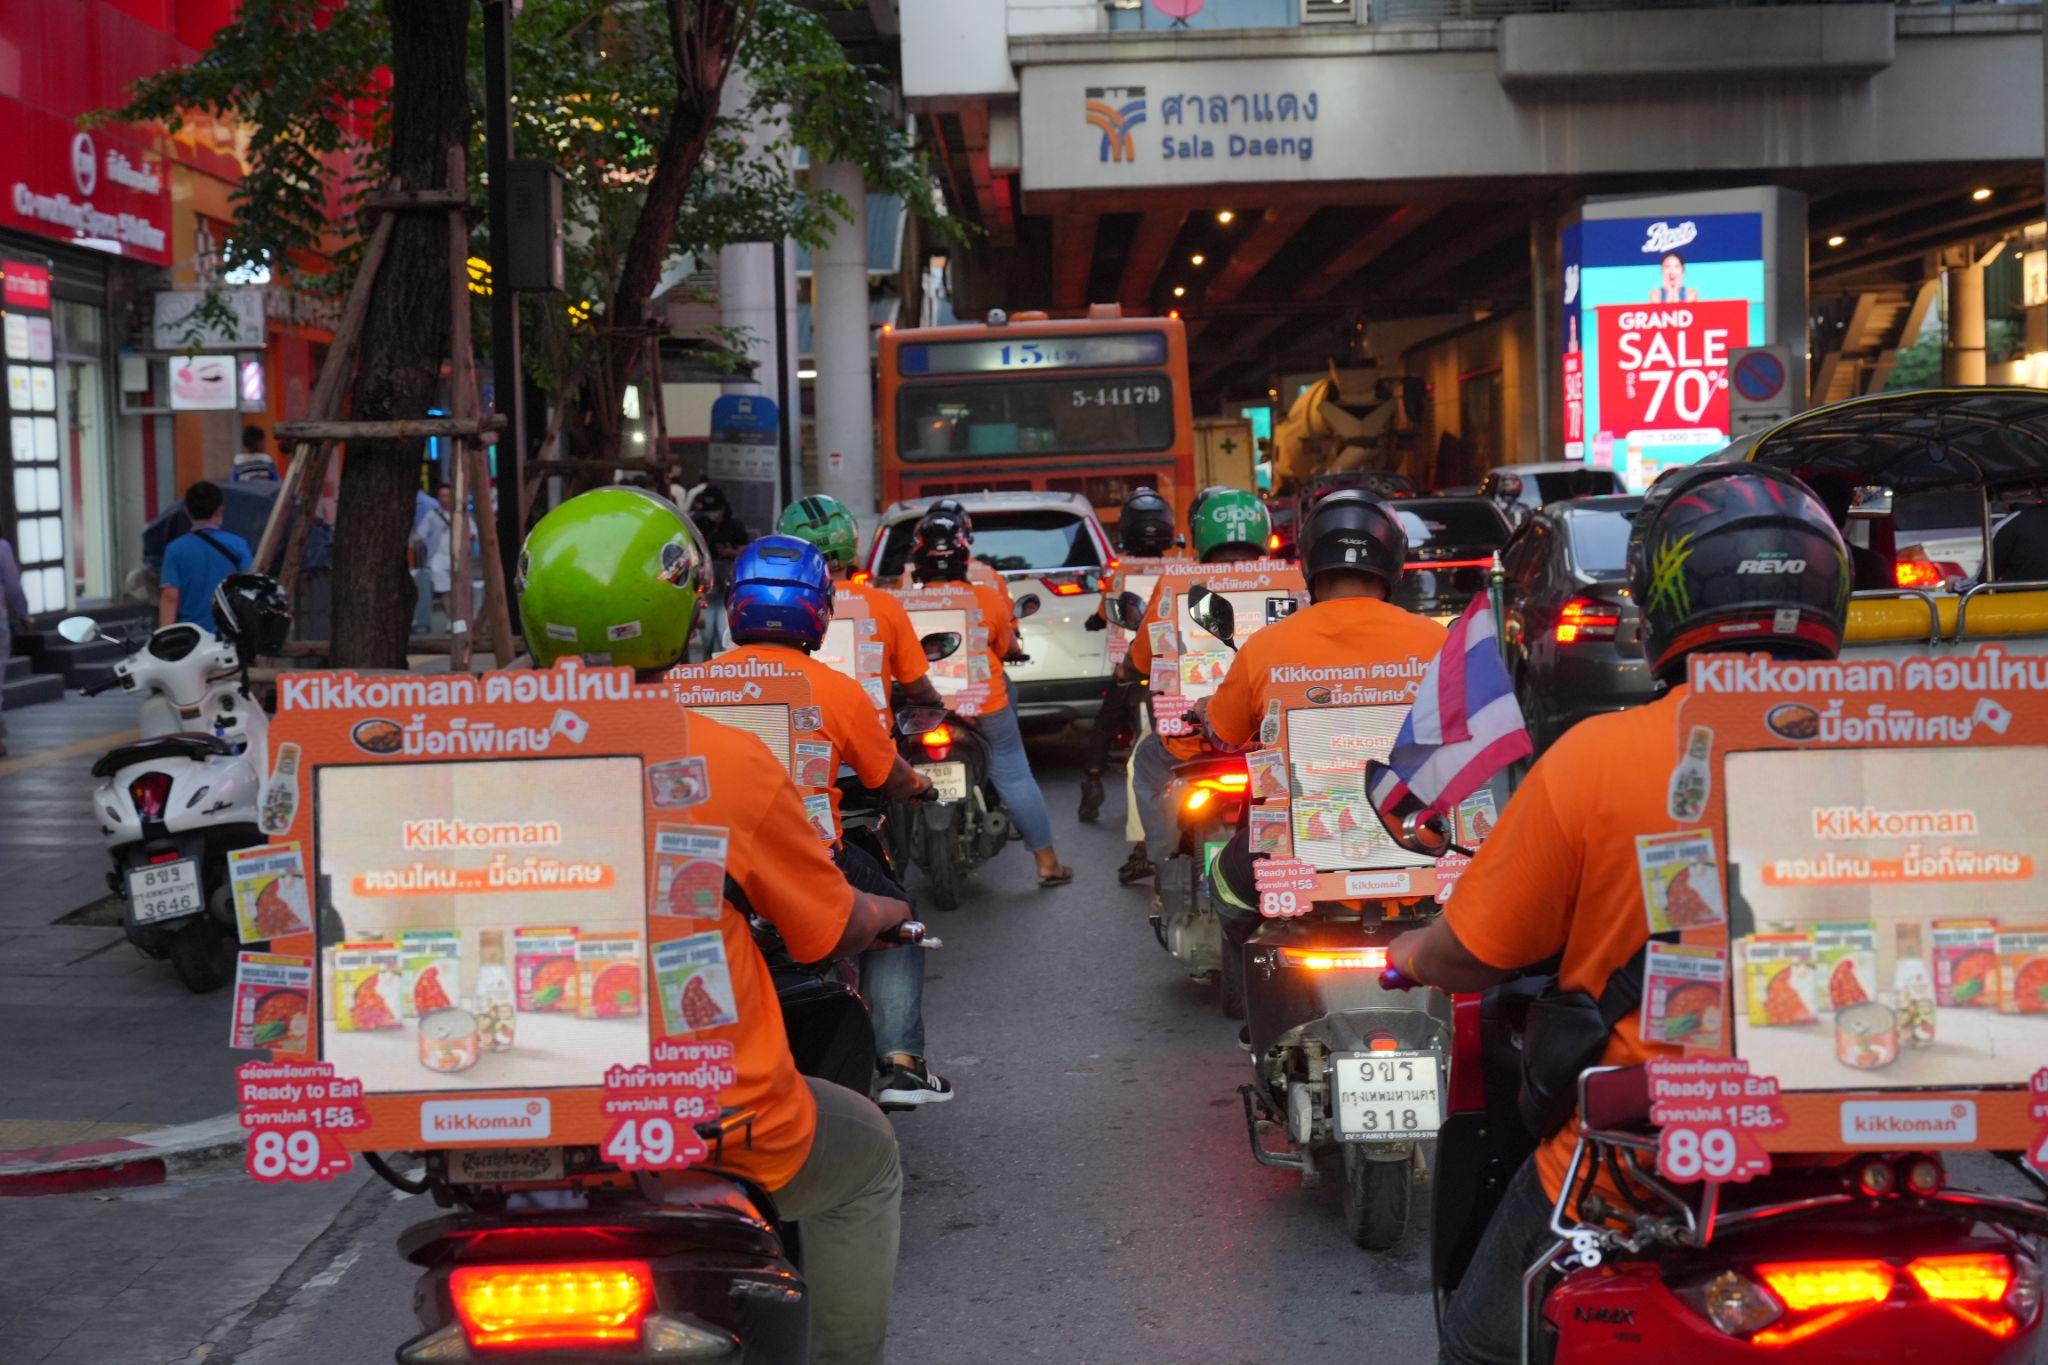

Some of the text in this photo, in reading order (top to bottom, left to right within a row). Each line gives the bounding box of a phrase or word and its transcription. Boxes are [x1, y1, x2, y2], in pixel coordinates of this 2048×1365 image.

[1161, 92, 1318, 125] ศาลาแดง
[1162, 134, 1313, 160] Sala Daeng
[1641, 220, 1698, 252] Boots
[1617, 309, 1693, 330] GRAND
[1001, 344, 1044, 366] 15
[1617, 328, 1729, 371] SALE
[1072, 386, 1161, 408] 5-44179
[1639, 366, 1729, 423] 70%
[1165, 562, 1232, 576] Kikkoman
[1736, 559, 1807, 575] REVO
[710, 657, 803, 679] ตอนไหน...
[1271, 665, 1367, 684] Kikkoman
[1694, 658, 1893, 694] Kikkoman
[282, 662, 669, 711] Kikkoman ตอนไหน...
[1330, 683, 1405, 705] มื้อก็พิเศษ
[1818, 699, 1973, 742] มื้อก็พิเศษ
[402, 713, 552, 756] มื้อก็พิเศษ
[1814, 809, 1976, 838] Kikkoman
[404, 822, 559, 850] Kikkoman
[1257, 866, 1315, 878] Ready to Eat
[1774, 844, 2020, 880] ตอนไหน... มื้อก็พิเศษ
[364, 857, 602, 891] ตอนไหน... มื้อก็พิเศษ
[144, 895, 192, 917] 3646
[1263, 890, 1310, 915] 89.-
[654, 1041, 729, 1061] ปลาซาบะ
[1360, 1061, 1414, 1082] 9ขร
[243, 1081, 360, 1104] Ready to Eat
[1341, 1089, 1436, 1106] กรุงเทพมหานคร
[1656, 1078, 1776, 1100] Ready to Eat
[434, 1115, 532, 1131] kikkoman
[1362, 1109, 1418, 1131] 318
[1855, 1115, 1957, 1132] kikkoman
[607, 1117, 701, 1165] 49.-
[1666, 1128, 1764, 1177] 89.-
[253, 1129, 346, 1177] 89.-
